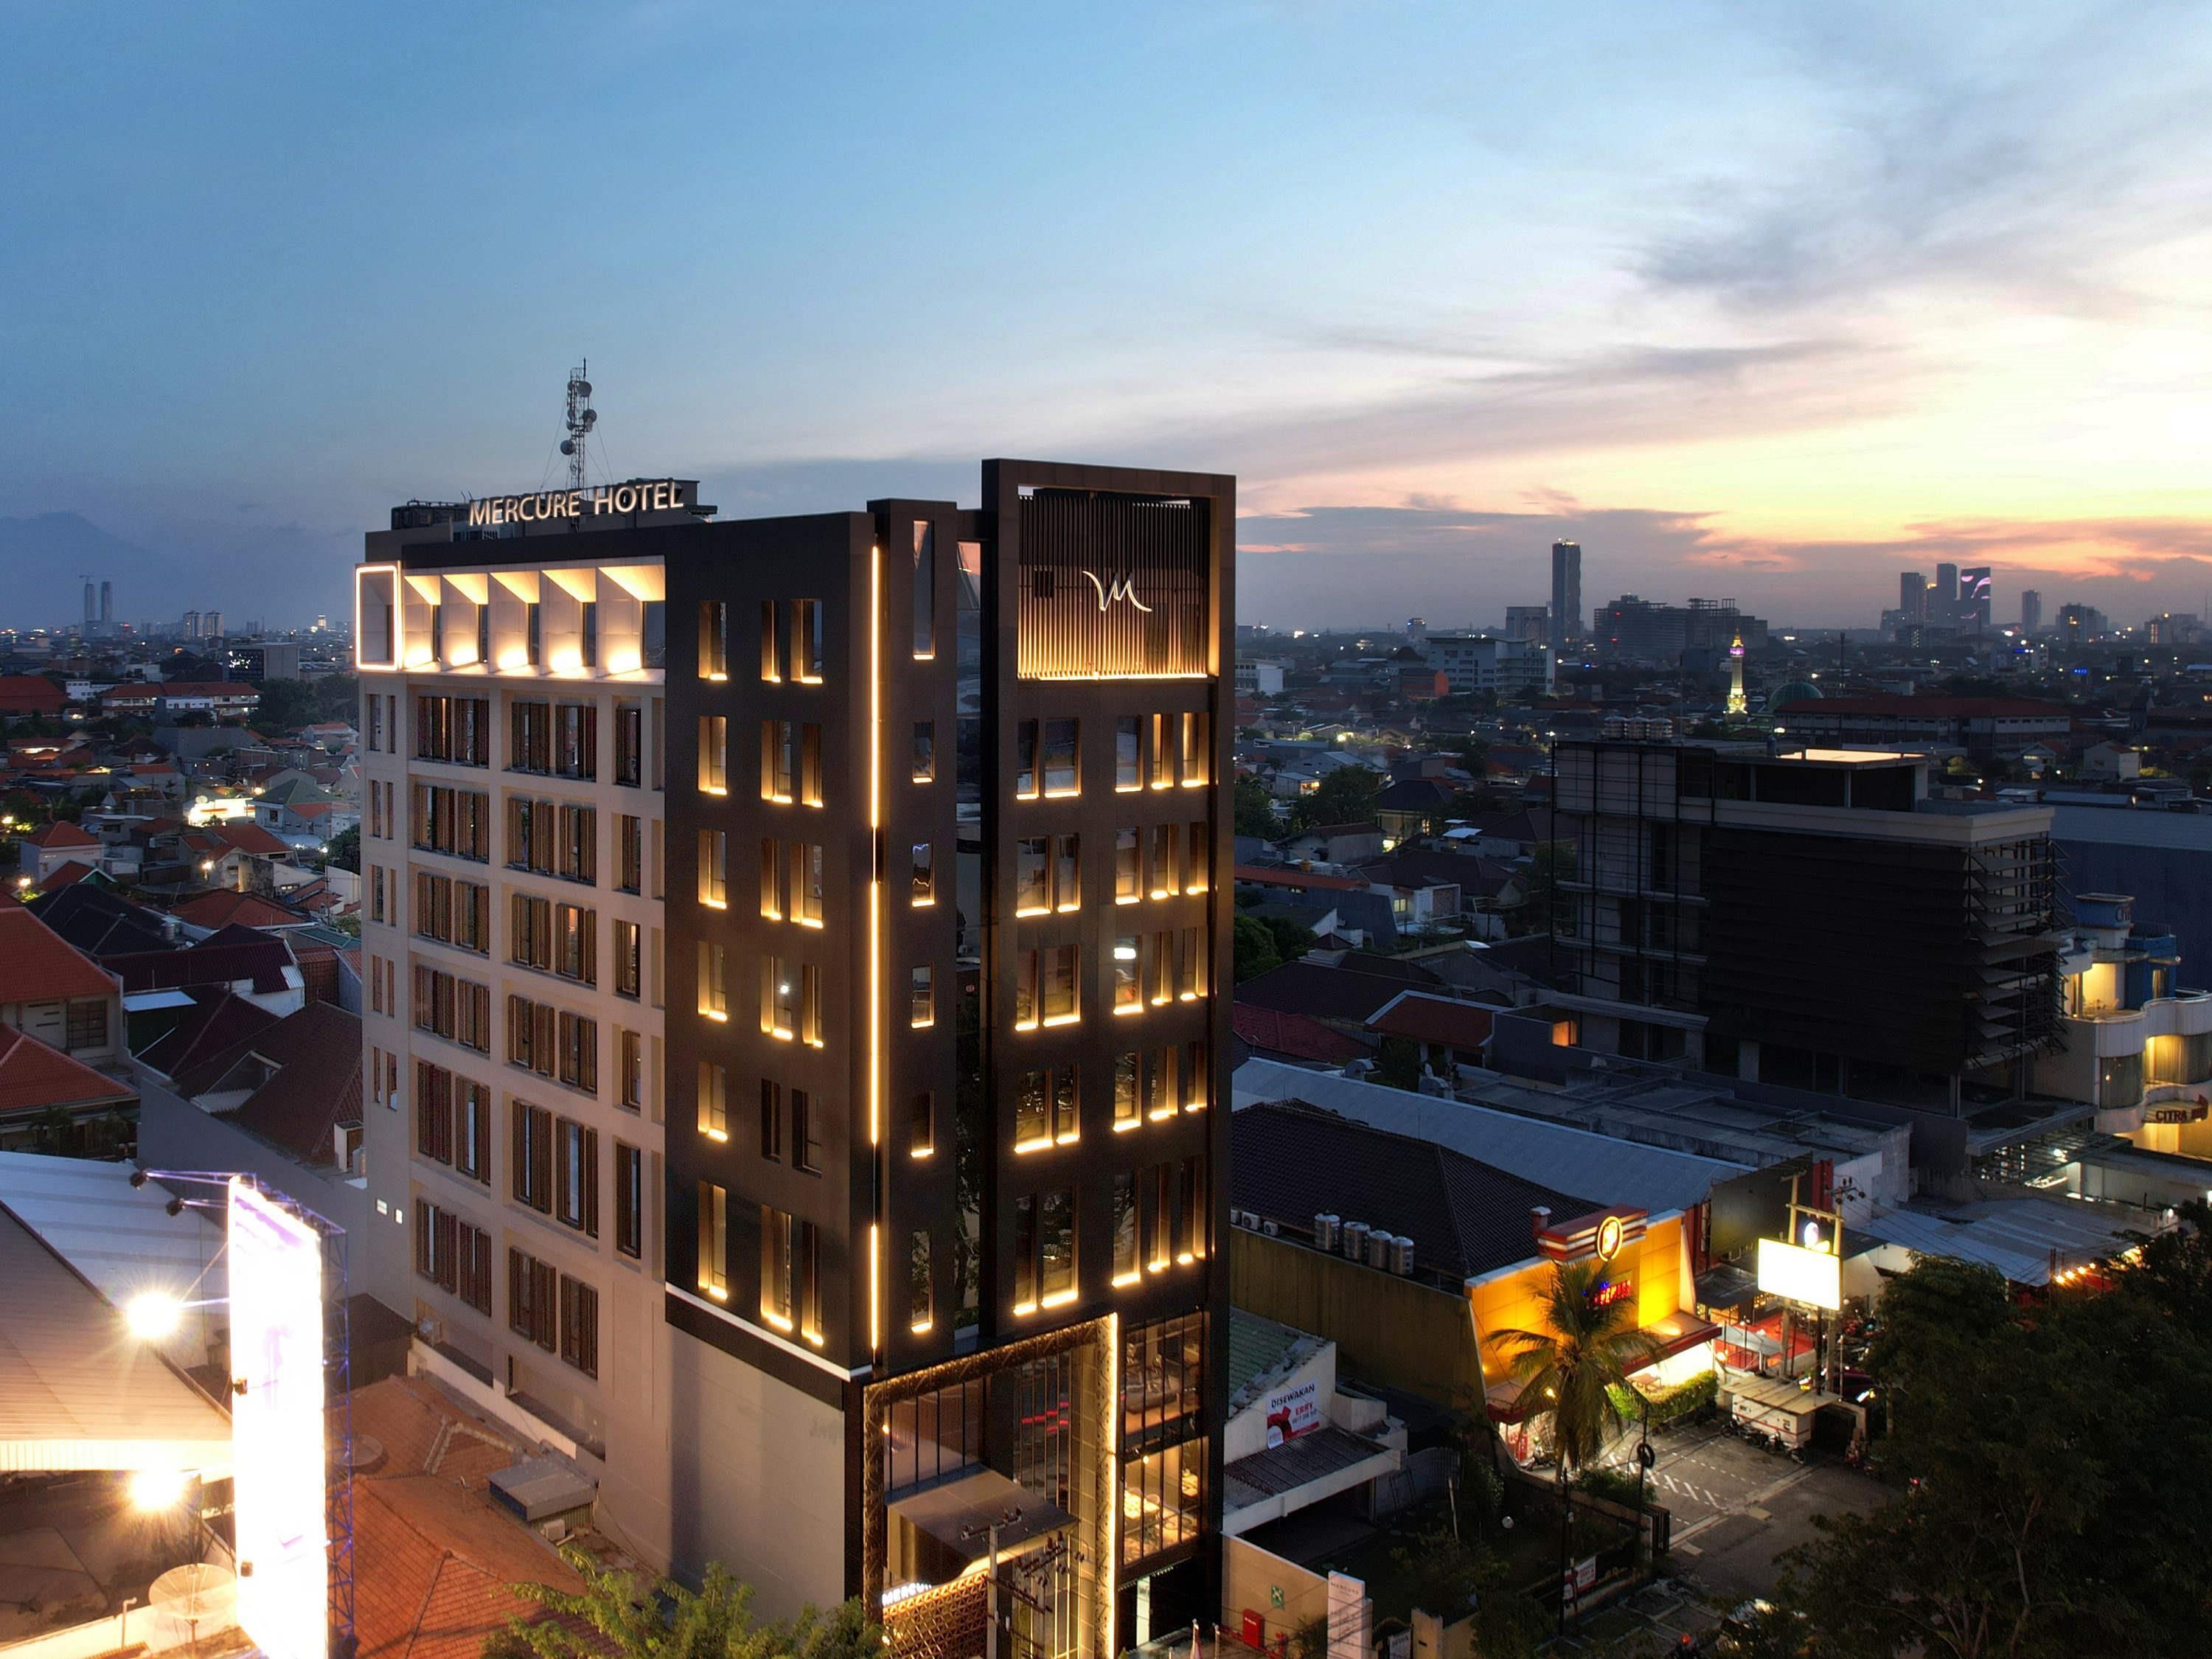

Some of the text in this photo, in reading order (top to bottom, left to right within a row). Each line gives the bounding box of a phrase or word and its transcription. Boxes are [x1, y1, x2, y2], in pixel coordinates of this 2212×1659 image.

[469, 480, 684, 526] MERCURE HOTEL
[2156, 1110, 2187, 1122] CITRA
[1271, 1383, 1315, 1408] DISEWAKAN
